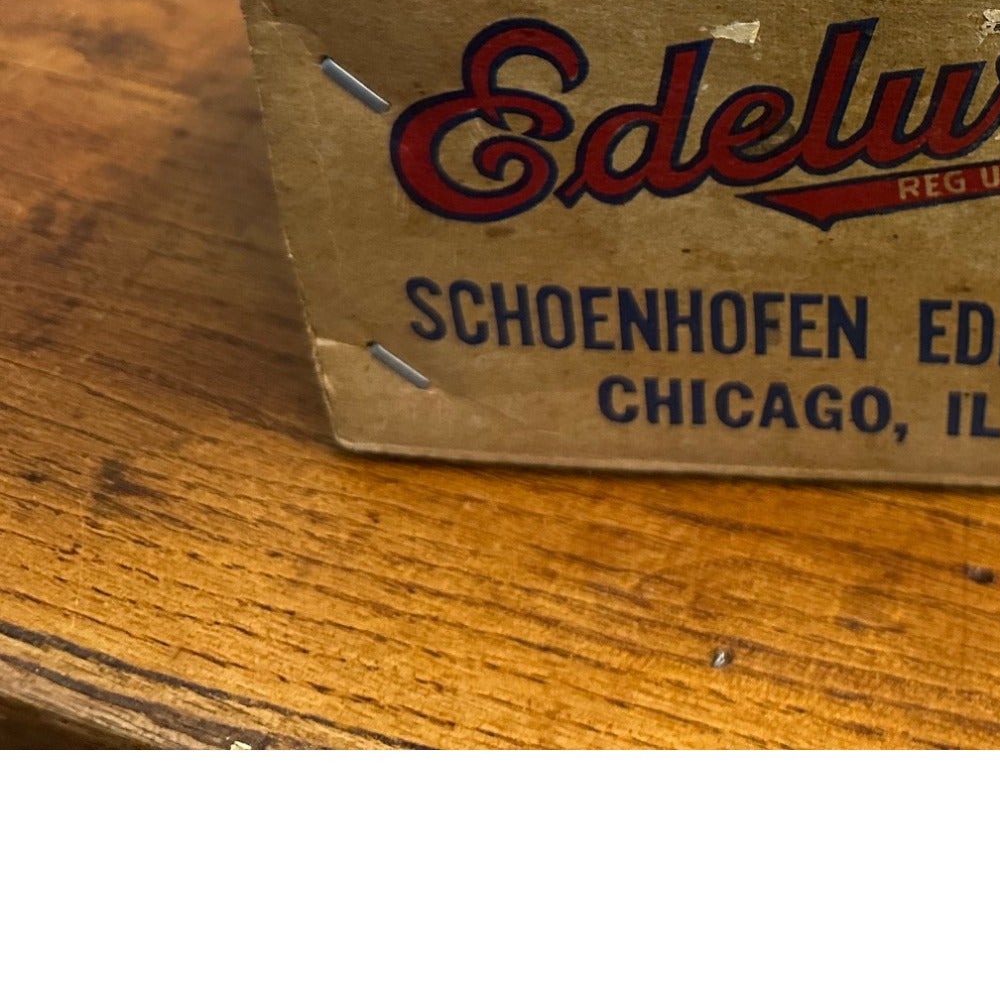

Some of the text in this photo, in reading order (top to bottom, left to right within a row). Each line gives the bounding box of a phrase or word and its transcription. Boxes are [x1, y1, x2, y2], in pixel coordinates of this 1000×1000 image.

[897, 171, 967, 200] REG
[405, 276, 869, 360] SCHOENHOFEN
[597, 374, 909, 443] CHICAGO,
